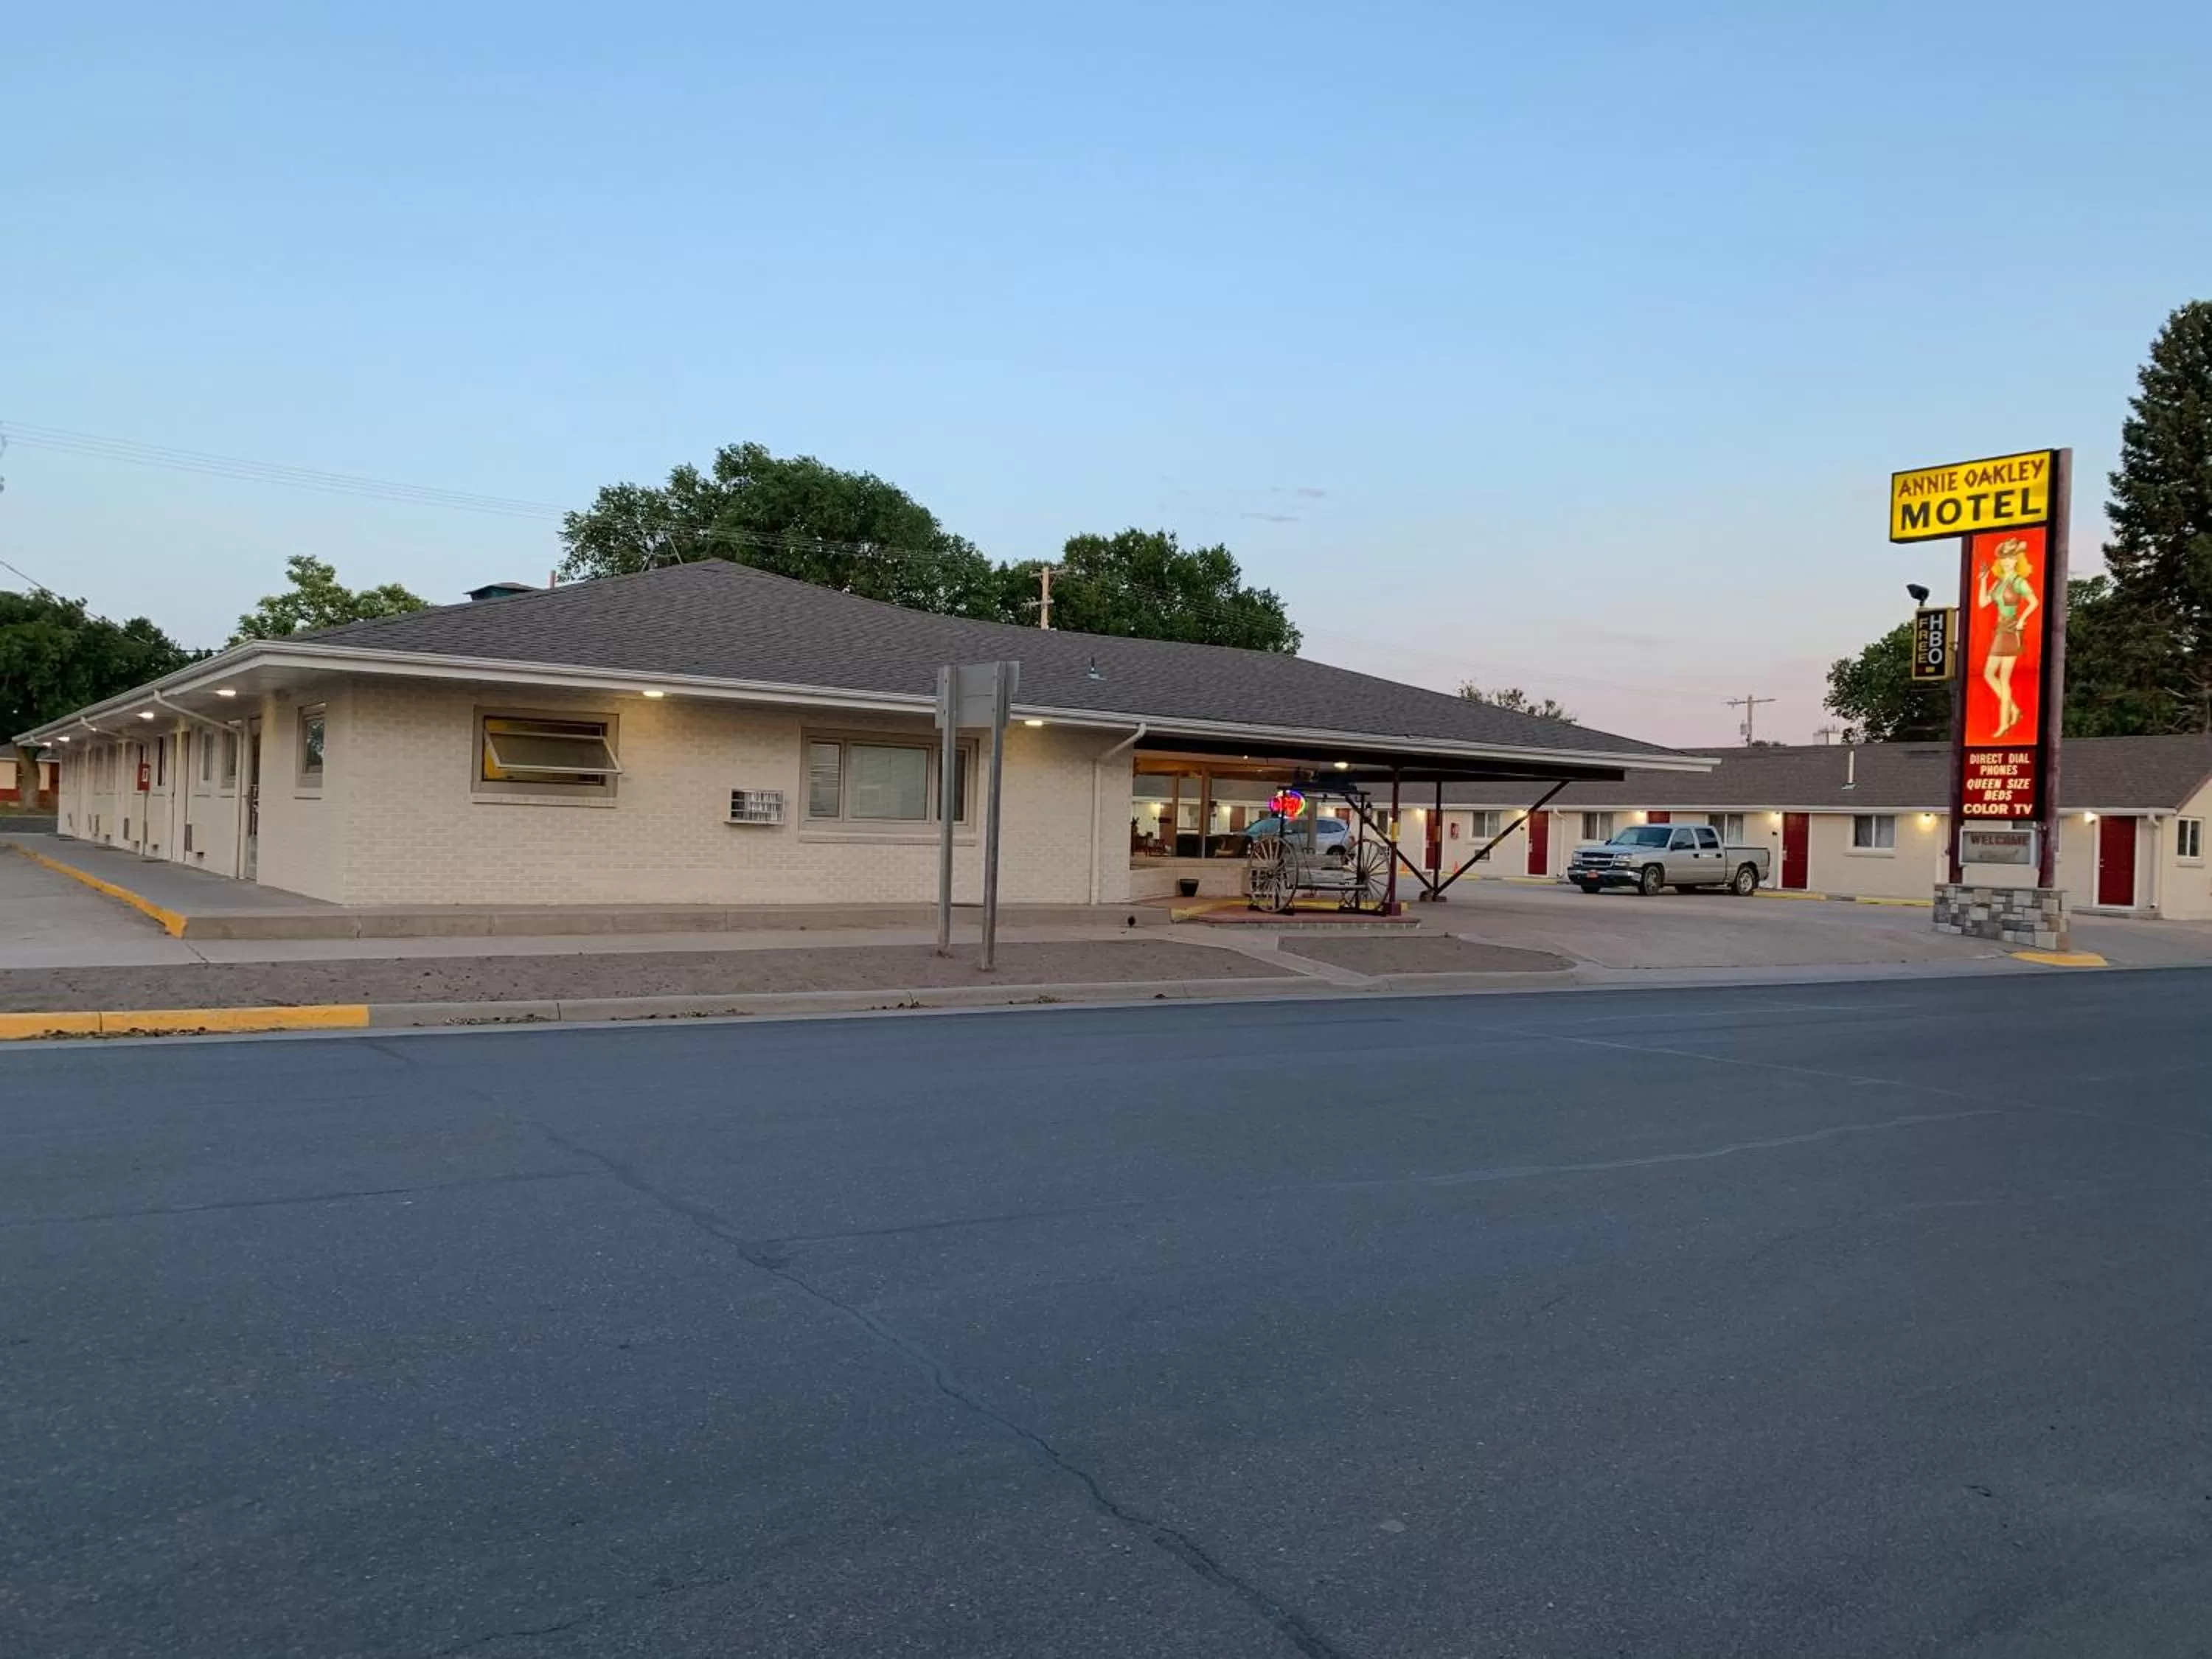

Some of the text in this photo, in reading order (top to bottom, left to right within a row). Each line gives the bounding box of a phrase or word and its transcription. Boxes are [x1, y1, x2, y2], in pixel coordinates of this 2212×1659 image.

[1898, 458, 2045, 498] ANNIE OAKLEY
[1900, 487, 2042, 531] MOTEL
[1918, 616, 1929, 664] FREE
[1928, 613, 1944, 664] HBO
[1969, 753, 2031, 765] DIRECT DIAL
[1980, 765, 2018, 776] PHONES
[1966, 778, 2031, 790] QUEEN SIZE
[1983, 790, 2014, 801] BEDS
[1963, 803, 2033, 815] COLOR TV
